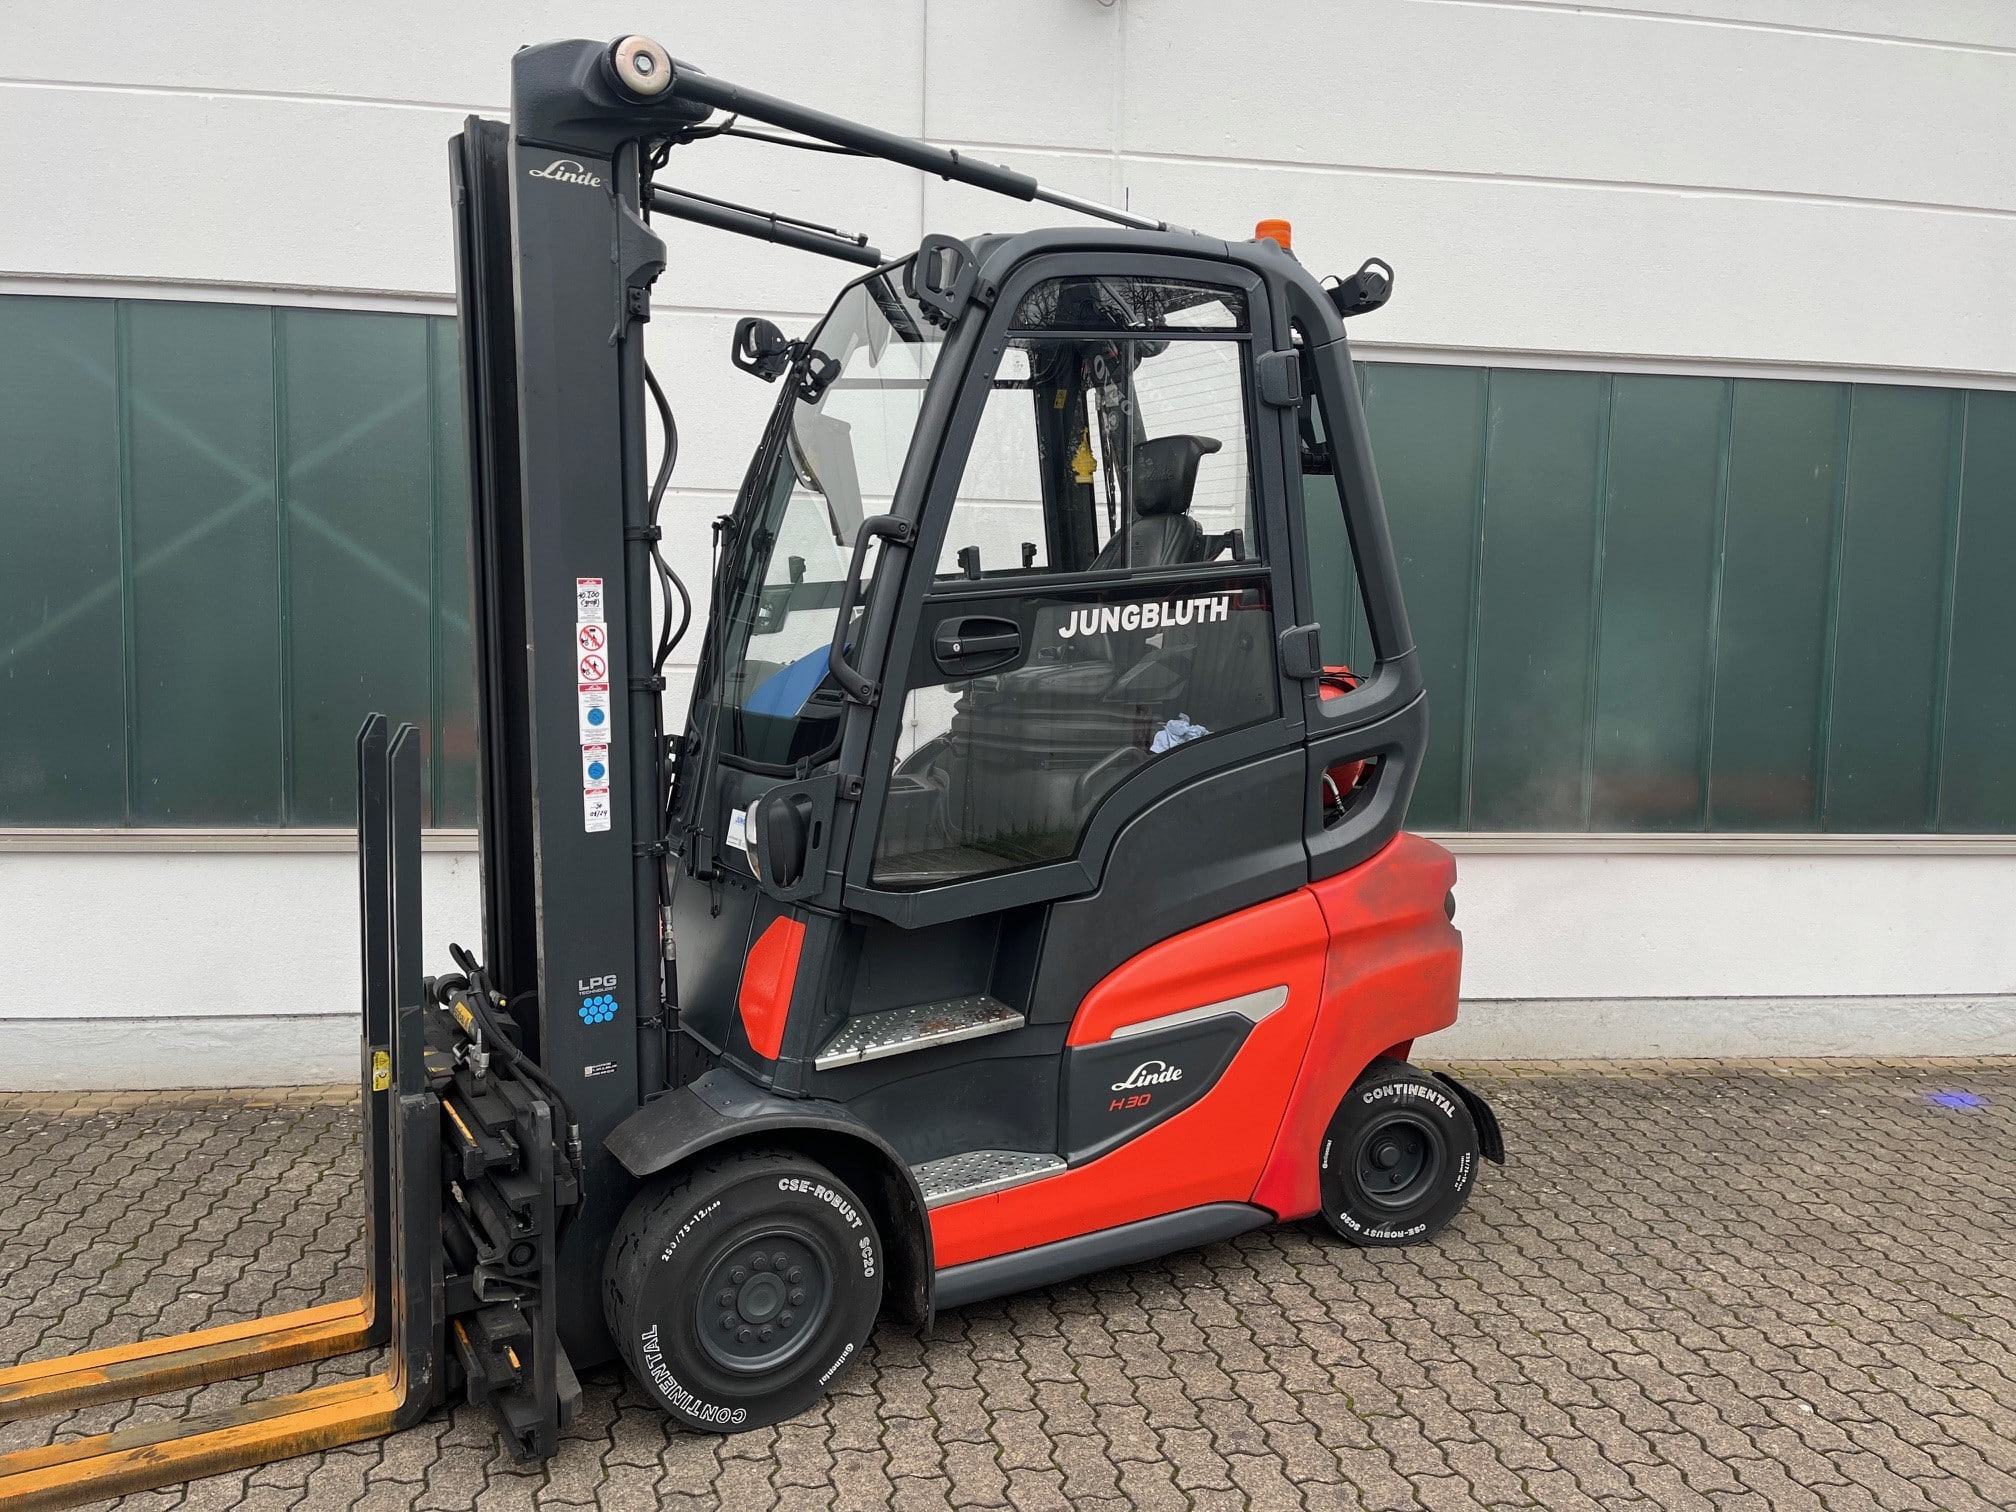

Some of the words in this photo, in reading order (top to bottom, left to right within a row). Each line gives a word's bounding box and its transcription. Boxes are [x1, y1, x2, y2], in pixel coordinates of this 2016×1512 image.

[529, 159, 601, 187] Linde
[1058, 596, 1229, 638] JUNGBLUTH
[578, 974, 617, 992] LPG
[578, 986, 617, 996] TECHNOLOGY
[1111, 1060, 1183, 1091] Linde
[1108, 1097, 1126, 1112] H
[1125, 1093, 1152, 1109] 30
[1362, 1083, 1458, 1119] CONTINENTAL
[778, 1178, 863, 1229] CSE-ROBUST
[858, 1236, 875, 1278] SC20
[1340, 1212, 1361, 1232] SC20
[1363, 1223, 1427, 1239] CSE-ROBUST
[641, 1324, 747, 1424] CONTINENTAL
